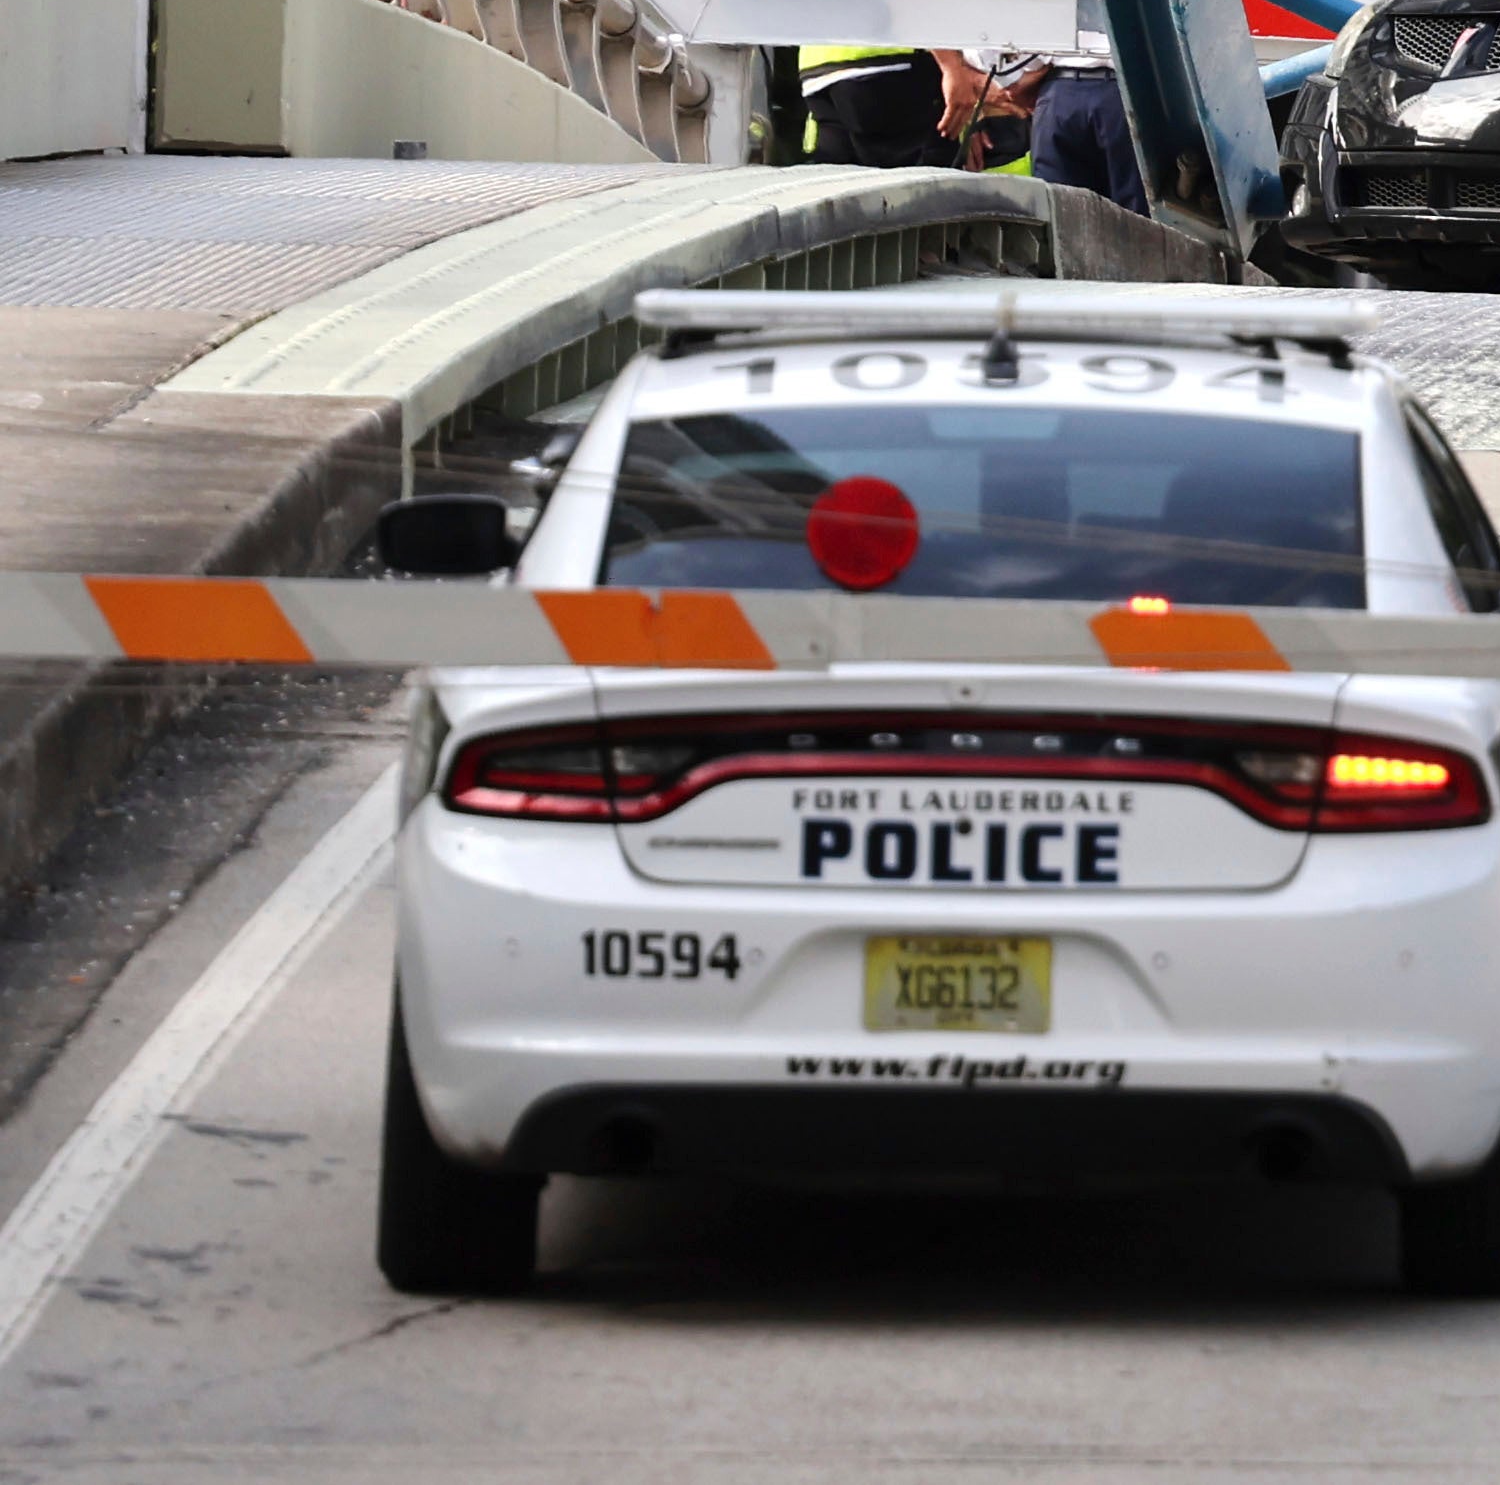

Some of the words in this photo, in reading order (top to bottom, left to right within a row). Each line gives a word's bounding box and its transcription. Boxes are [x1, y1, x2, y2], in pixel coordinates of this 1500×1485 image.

[793, 789, 884, 812] FORT
[900, 789, 1135, 814] LAUDERDALE
[799, 818, 1121, 884] POLICE
[581, 930, 741, 981] 10594
[894, 963, 1021, 1011] XG6132
[786, 1052, 1126, 1091] www.flpd.org
